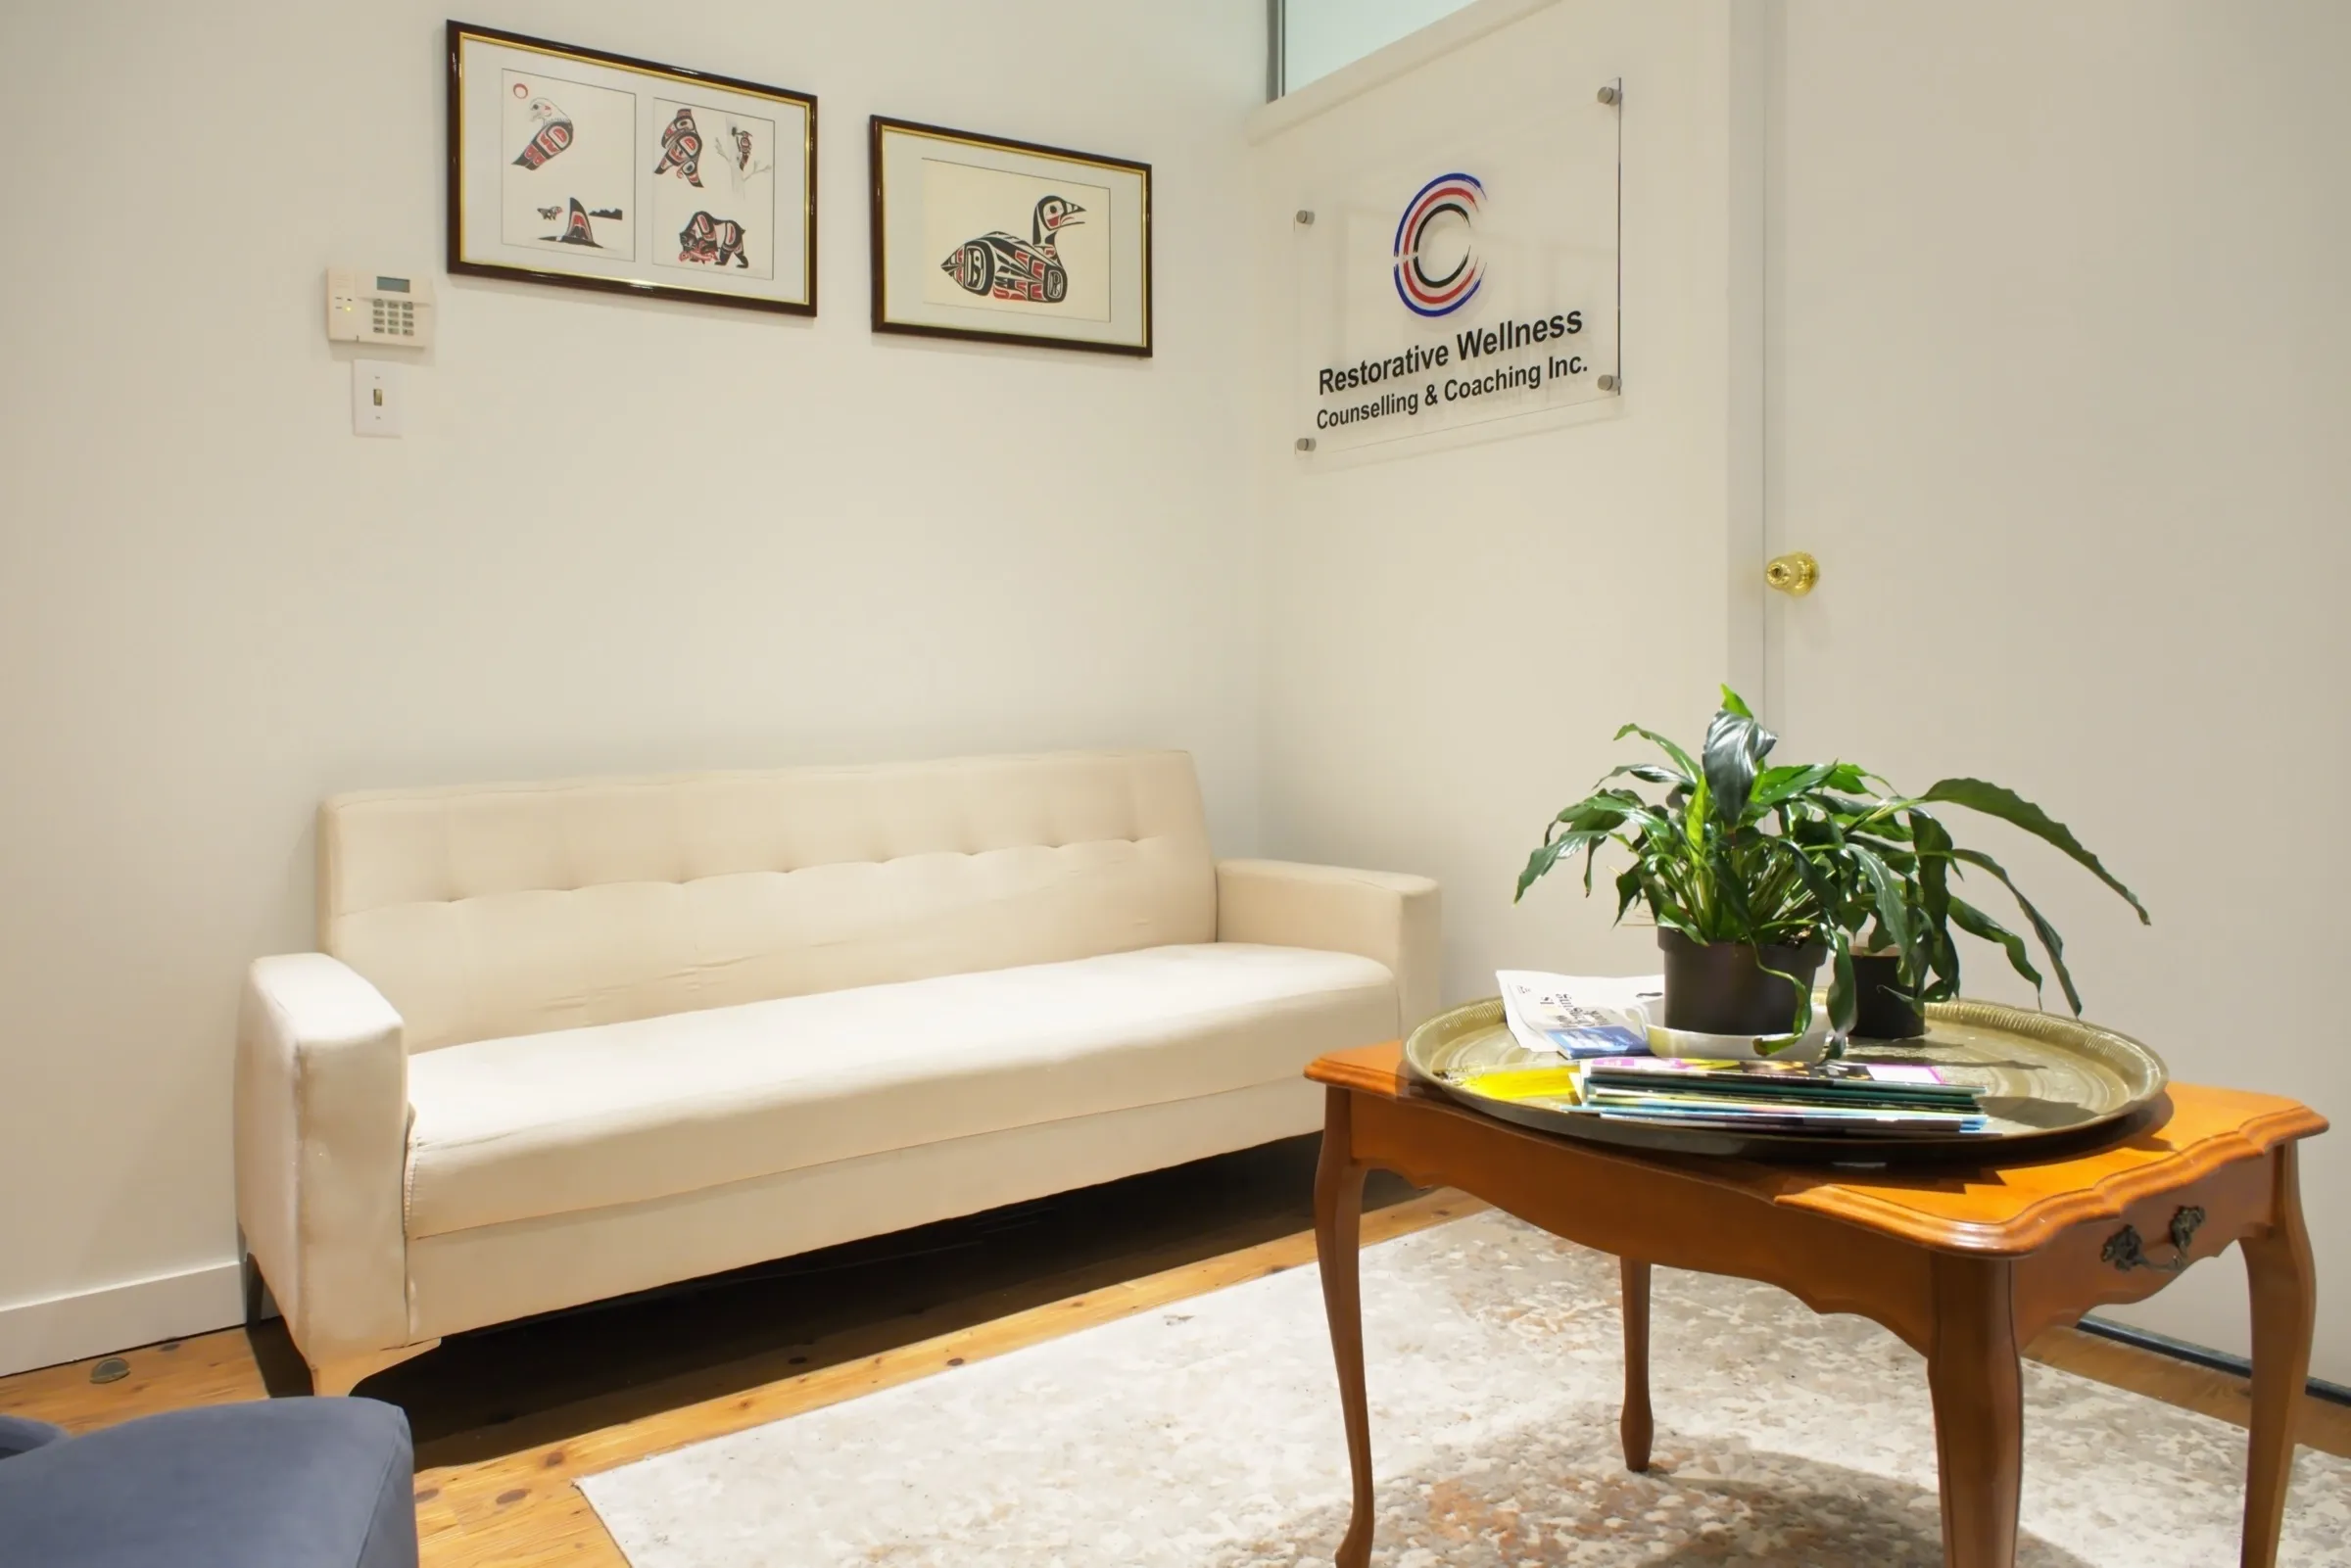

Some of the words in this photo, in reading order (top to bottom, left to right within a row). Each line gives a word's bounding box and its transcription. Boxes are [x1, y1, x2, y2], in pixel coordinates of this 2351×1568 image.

[1319, 345, 1449, 396] Restorative
[1456, 309, 1583, 360] Wellness
[1317, 392, 1419, 430] Counselling
[1424, 383, 1438, 406] &
[1444, 365, 1541, 402] Coaching
[1549, 356, 1588, 379] Inc.
